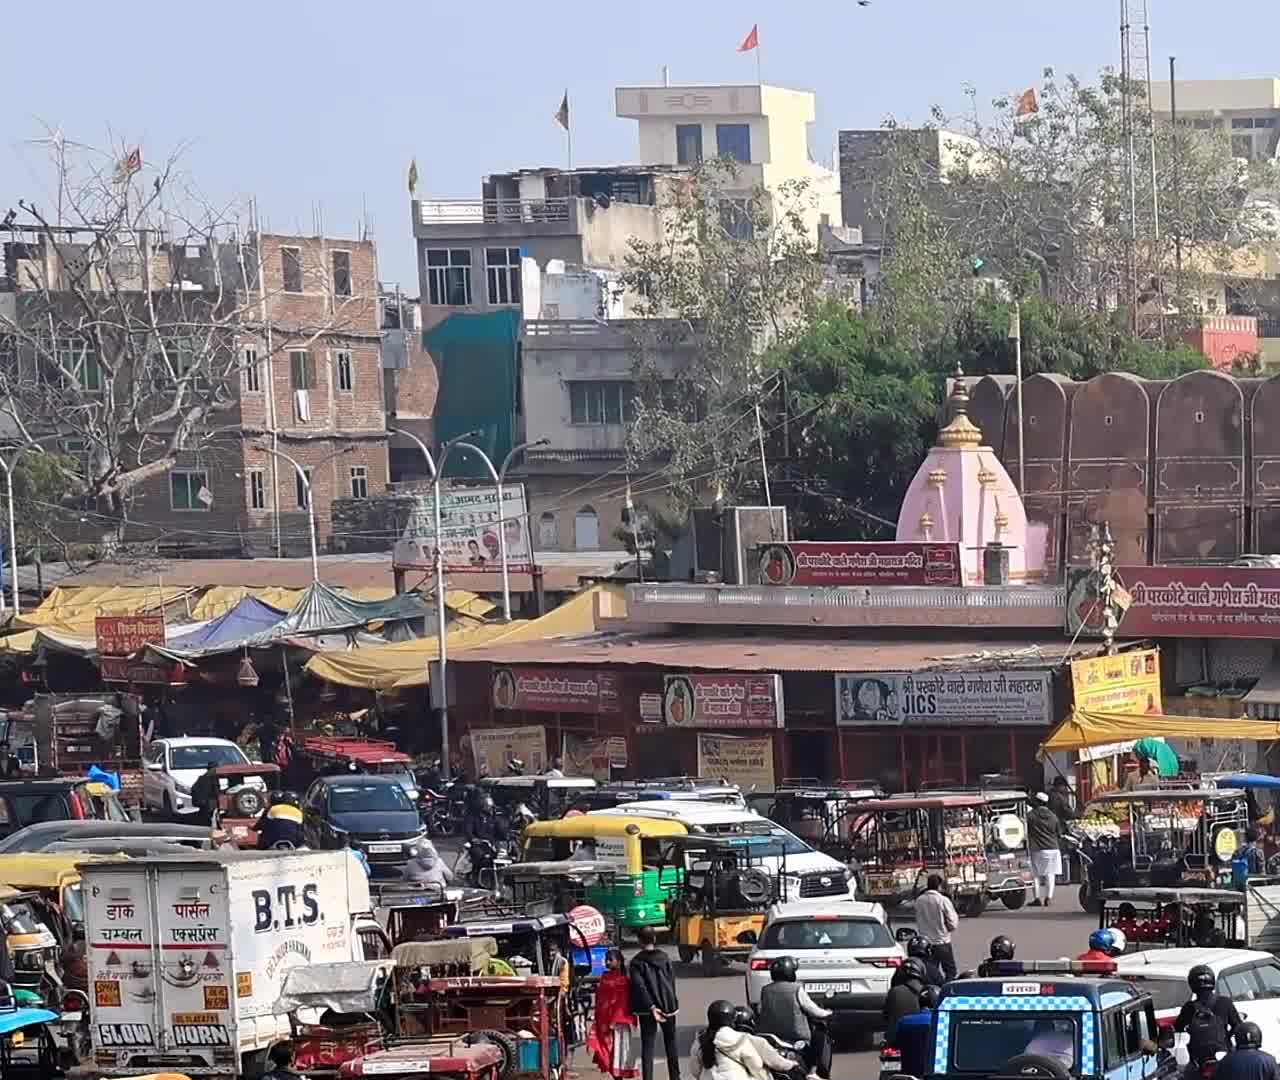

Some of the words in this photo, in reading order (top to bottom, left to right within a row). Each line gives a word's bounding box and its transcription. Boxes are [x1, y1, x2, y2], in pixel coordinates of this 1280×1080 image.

[1148, 582, 1186, 605] परकोटे
[1187, 582, 1210, 605] वाले
[1211, 582, 1242, 606] गणेश
[1243, 582, 1258, 606] जी
[916, 676, 945, 694] परकोटे
[947, 675, 965, 694] वाले
[967, 677, 992, 694] गणेश
[994, 675, 1006, 694] जी
[1008, 679, 1043, 694] महाराज
[902, 695, 936, 714] JICS
[106, 905, 134, 920] डाक
[172, 903, 210, 919] पार्सल
[252, 883, 325, 931] B.T.S.
[101, 929, 143, 942] चम्बल
[101, 1024, 152, 1046] SLOW
[175, 1024, 229, 1045] HORN
